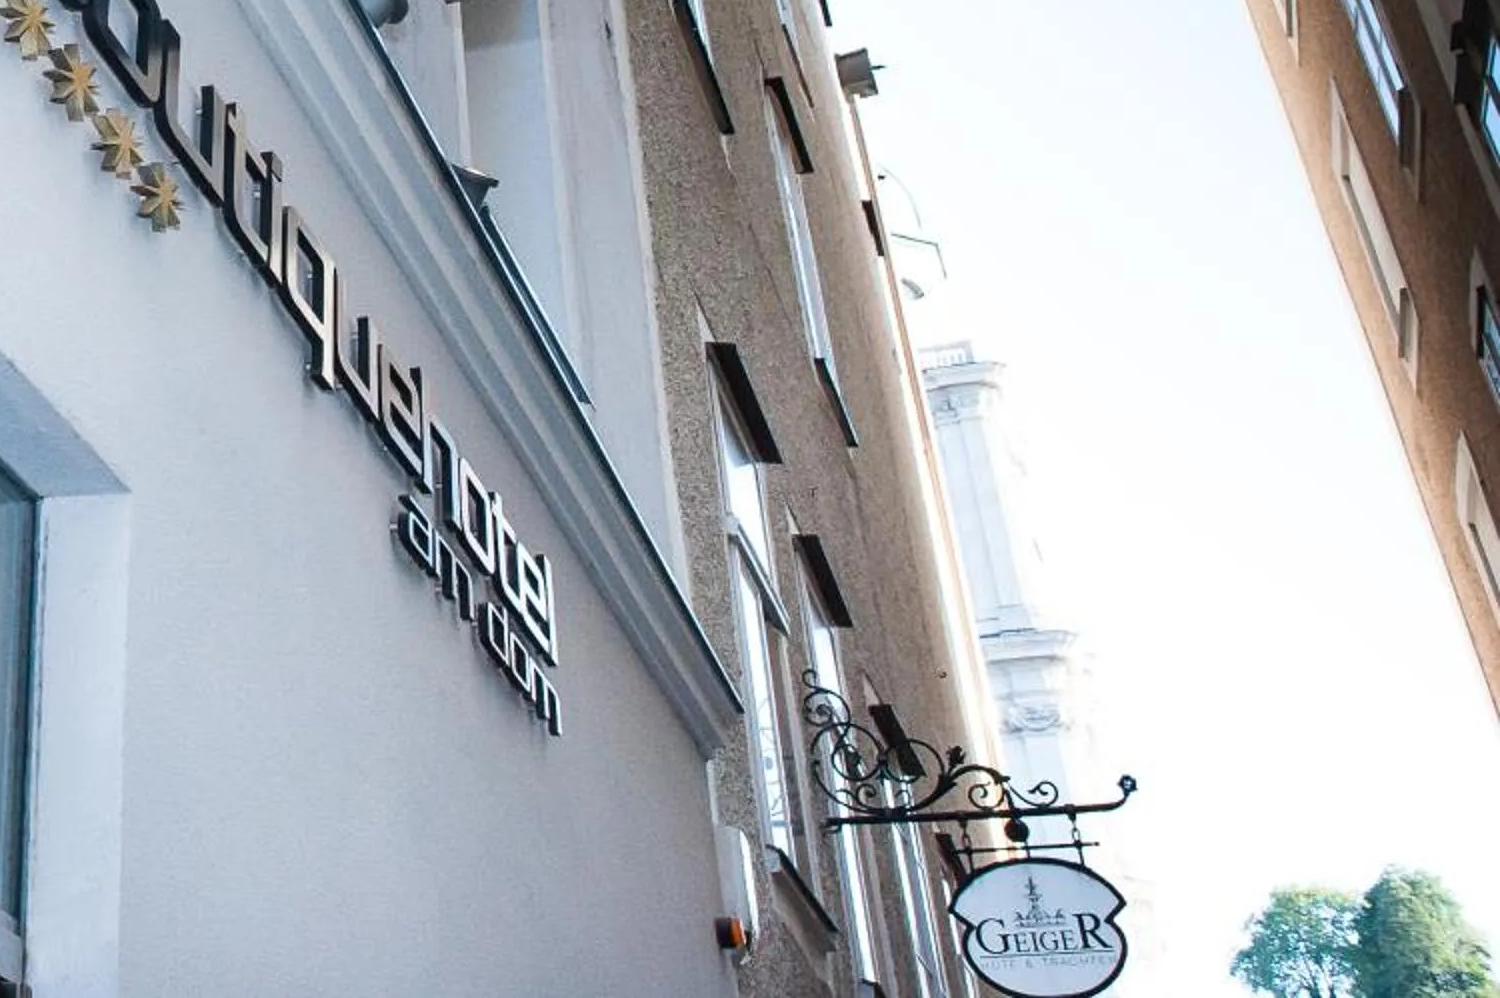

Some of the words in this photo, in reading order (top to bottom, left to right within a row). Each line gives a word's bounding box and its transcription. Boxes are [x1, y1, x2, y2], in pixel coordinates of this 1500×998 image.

[397, 494, 476, 622] am
[477, 599, 562, 737] dom
[975, 912, 1114, 955] GEIGER
